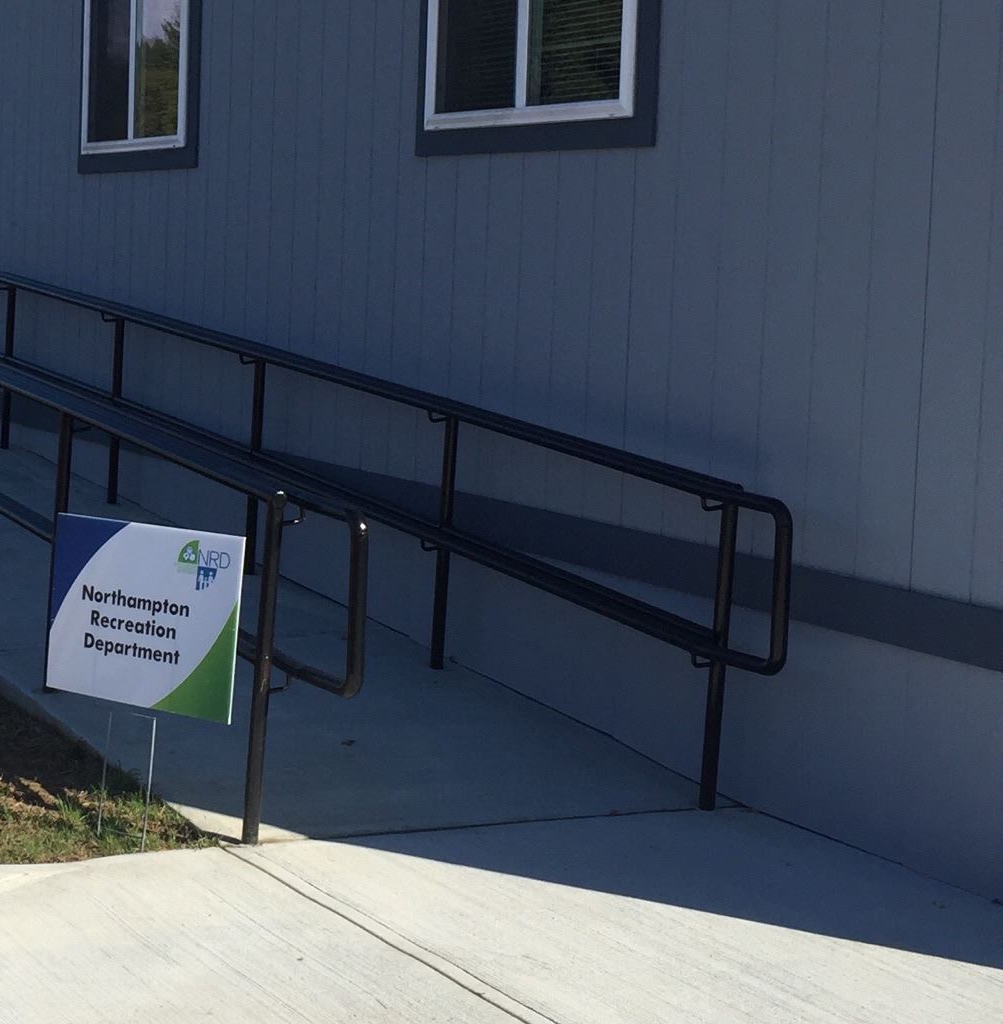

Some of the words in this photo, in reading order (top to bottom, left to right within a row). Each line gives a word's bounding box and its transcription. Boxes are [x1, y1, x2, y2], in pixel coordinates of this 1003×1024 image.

[198, 549, 231, 569] NRD
[81, 584, 190, 617] Northampton
[90, 609, 177, 640] Recreation
[83, 632, 180, 665] Department
